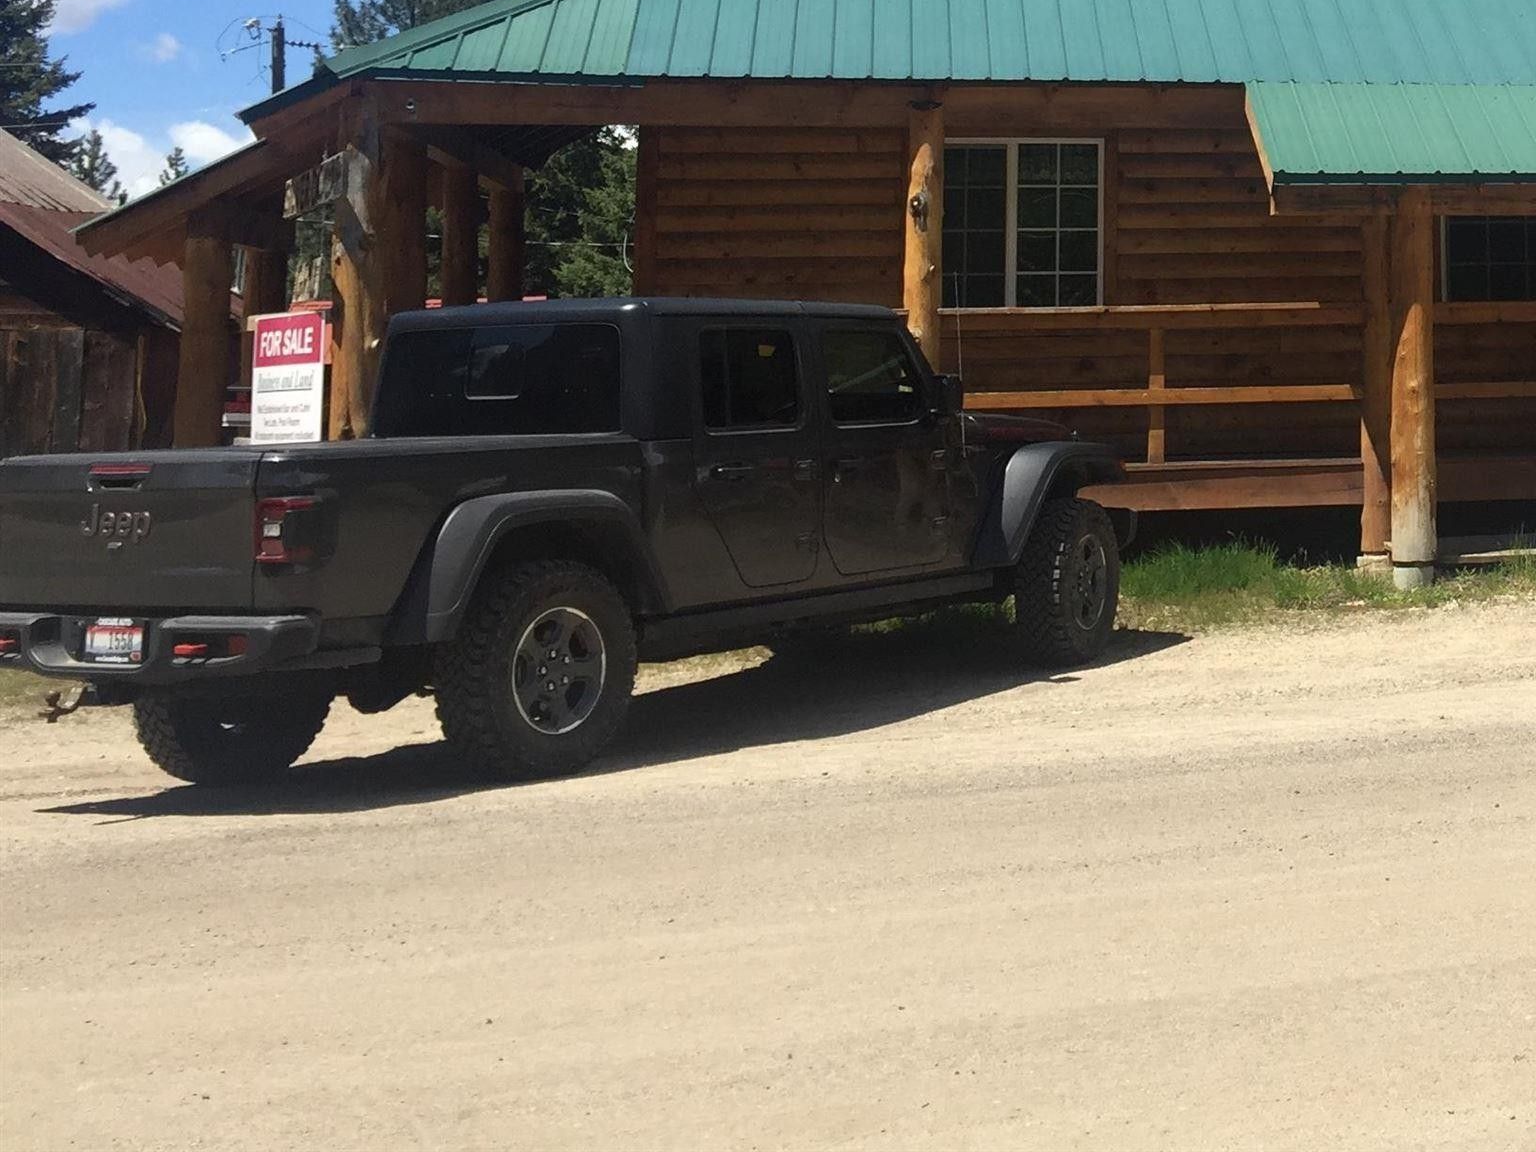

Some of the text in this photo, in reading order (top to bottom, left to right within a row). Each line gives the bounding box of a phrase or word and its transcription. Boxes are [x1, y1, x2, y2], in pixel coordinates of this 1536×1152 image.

[259, 326, 314, 358] FOR SALE
[81, 504, 150, 544] Jeep
